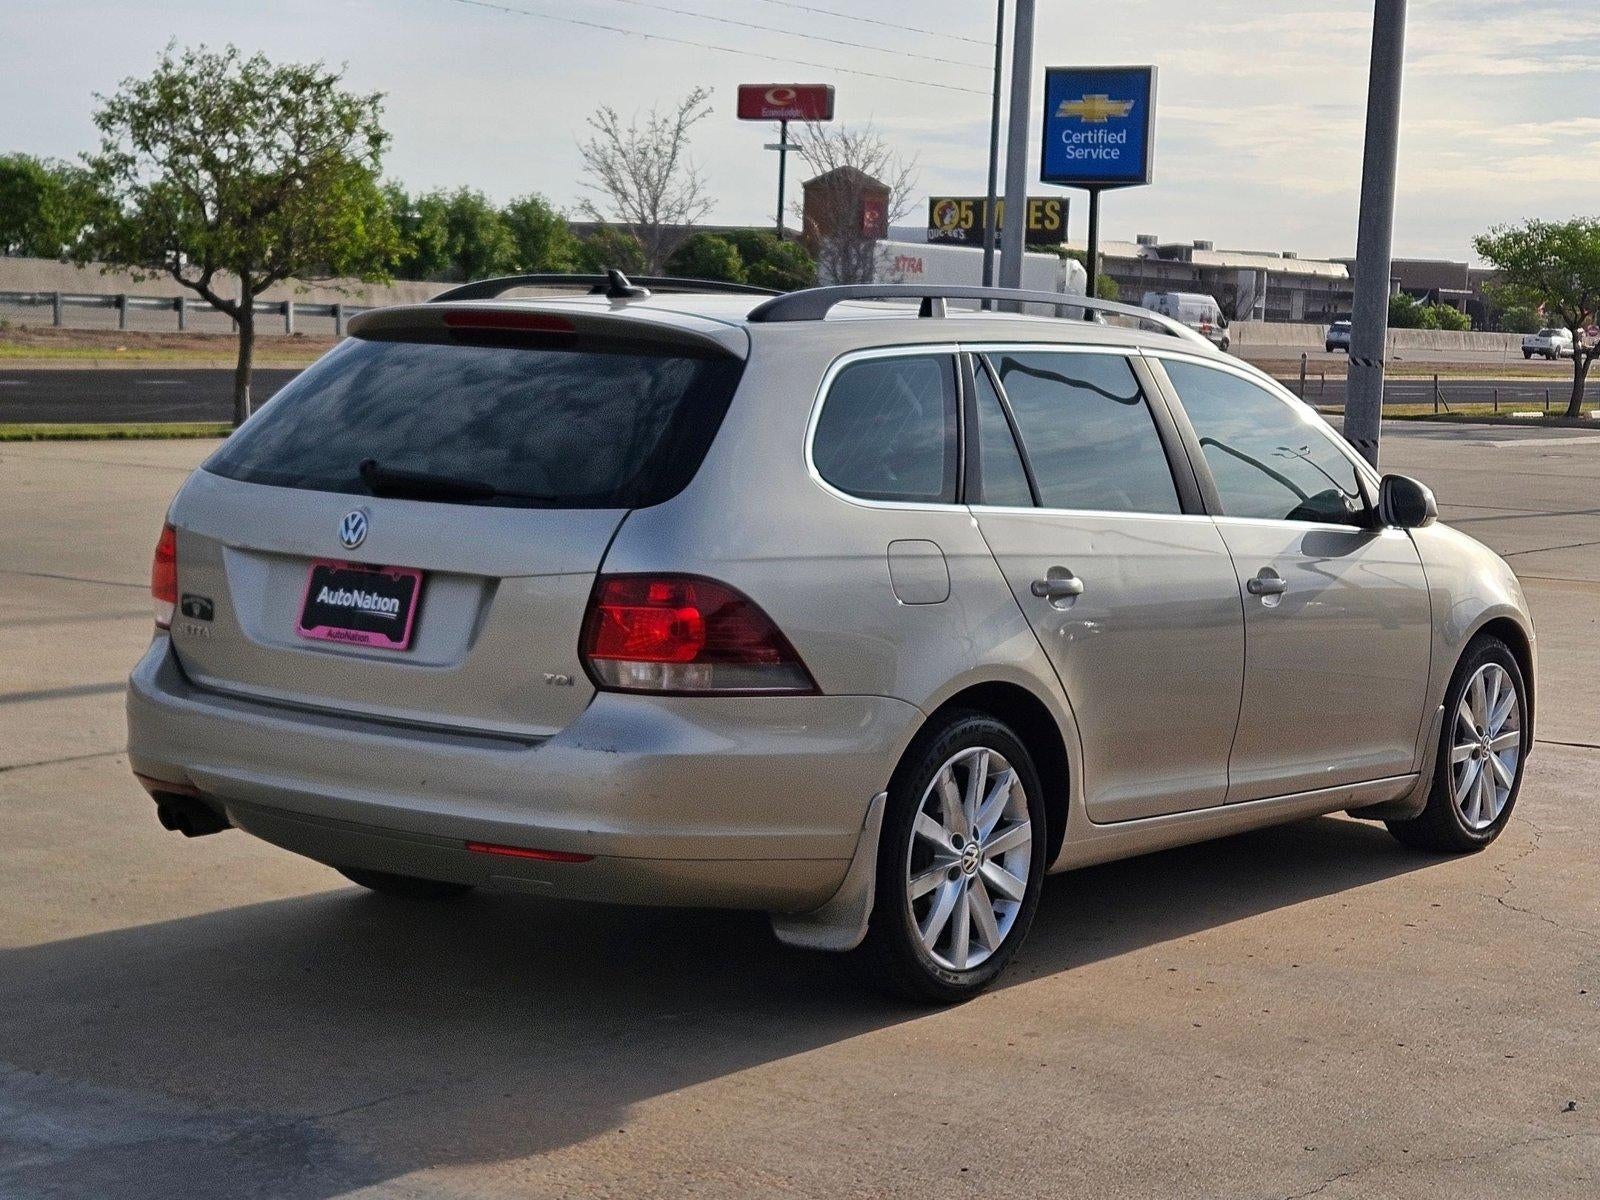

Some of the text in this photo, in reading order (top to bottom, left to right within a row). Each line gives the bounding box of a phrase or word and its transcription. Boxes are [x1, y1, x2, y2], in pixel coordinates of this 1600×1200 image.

[1061, 128, 1127, 144] Certified
[1065, 145, 1120, 159] Service
[960, 200, 1060, 230] 5 MES
[316, 586, 400, 613] AutoNation
[326, 629, 370, 642] AutoNation
